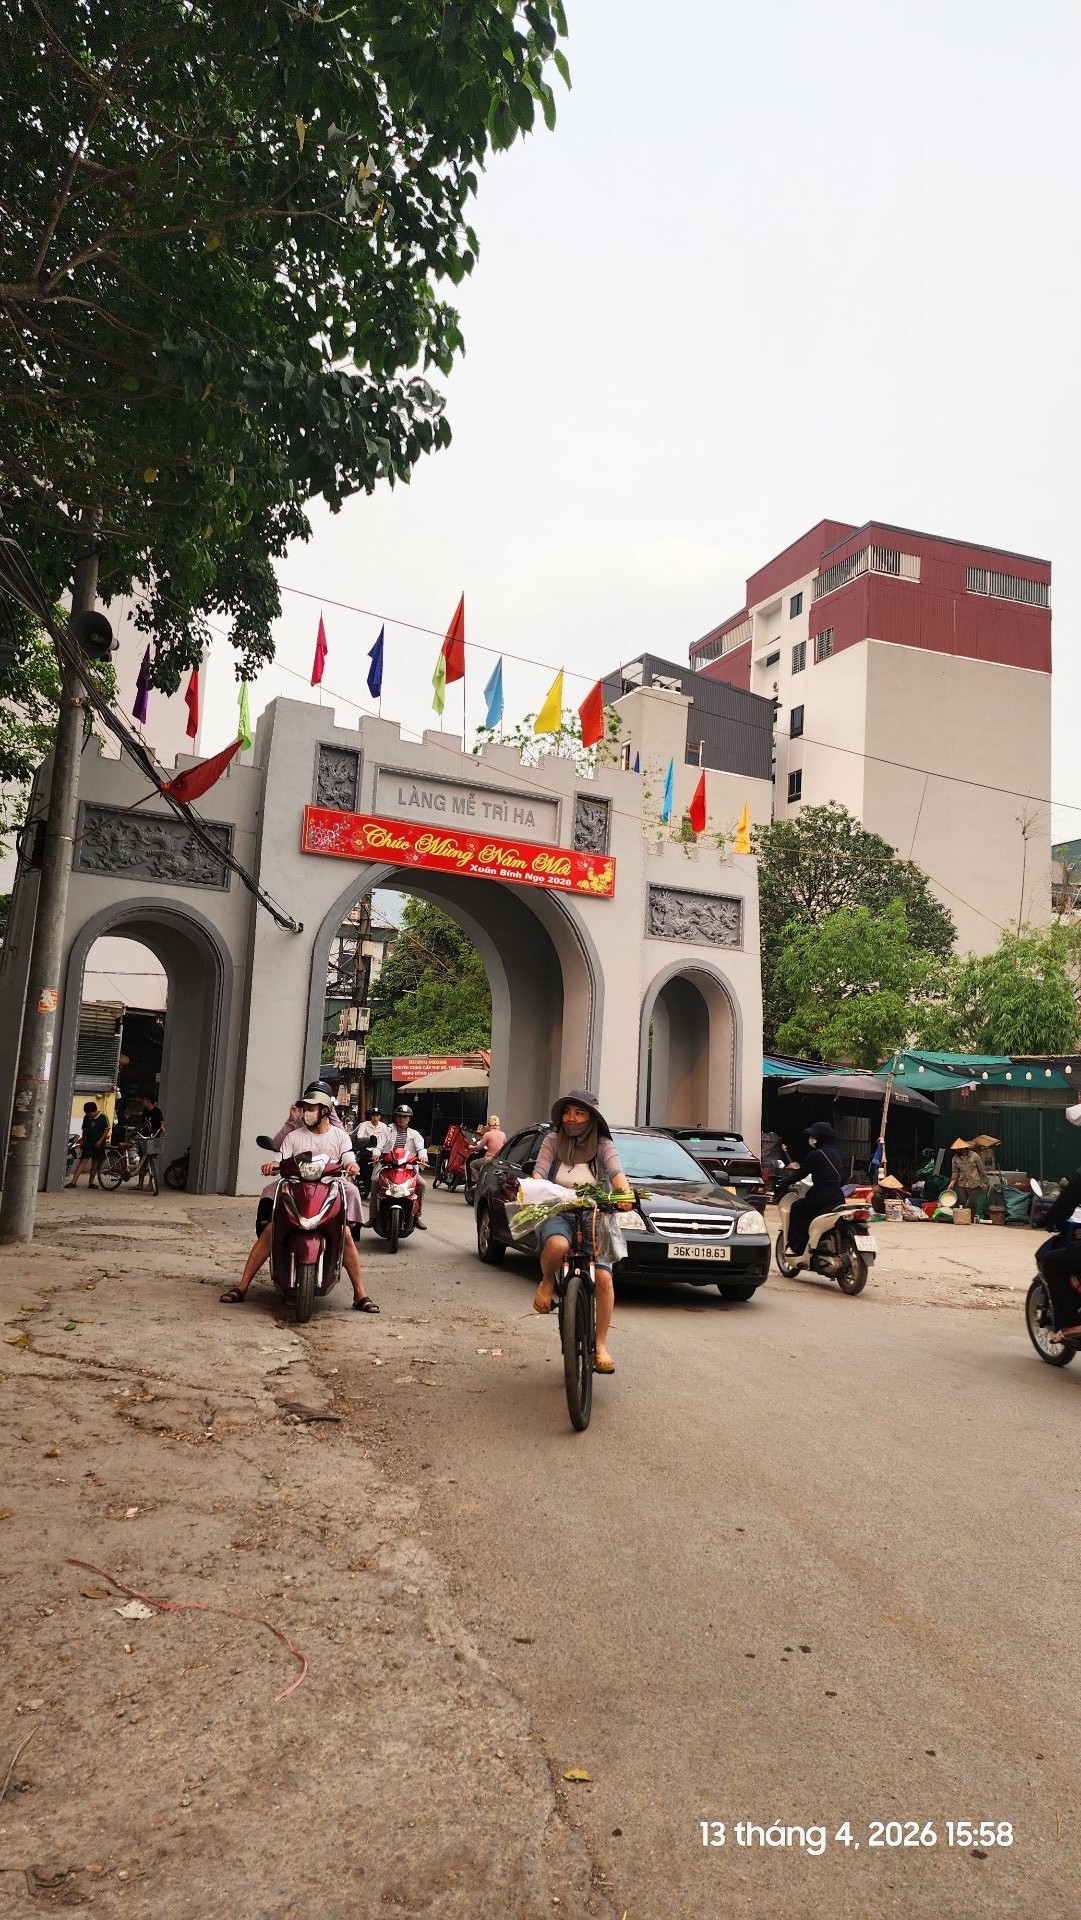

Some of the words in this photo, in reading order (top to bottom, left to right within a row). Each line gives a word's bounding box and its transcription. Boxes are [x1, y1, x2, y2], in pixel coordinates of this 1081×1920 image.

[398, 785, 446, 811] LÀNG
[452, 791, 476, 816] MỄ
[482, 801, 508, 821] TRÌ
[513, 808, 535, 827] HẠ
[363, 823, 410, 850] Chúc
[415, 833, 474, 867] Mừng
[478, 844, 527, 869] Năm
[532, 853, 571, 876] Mới
[470, 864, 497, 875] Xuân
[499, 869, 522, 879] Bính
[525, 872, 545, 884] Ngọ
[547, 876, 572, 886] 2026
